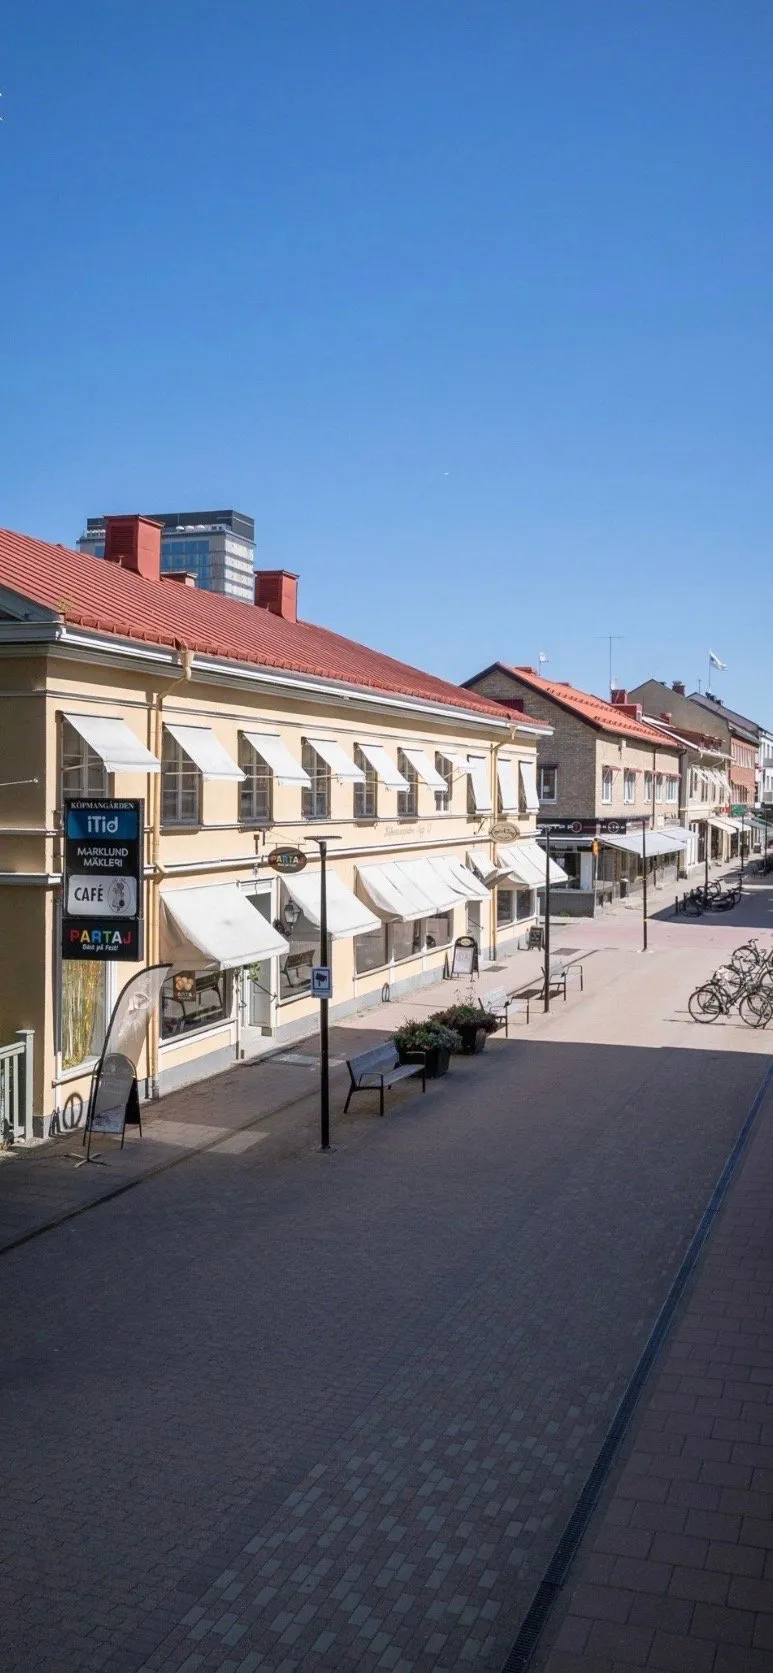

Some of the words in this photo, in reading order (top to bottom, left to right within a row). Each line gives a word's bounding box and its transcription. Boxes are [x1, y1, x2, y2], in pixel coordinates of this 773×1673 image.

[87, 815, 119, 833] iTid
[77, 847, 129, 857] MARKLUND
[83, 856, 123, 867] MÄKLERI
[74, 884, 104, 902] CAFÉ
[70, 929, 132, 945] PARTAJ
